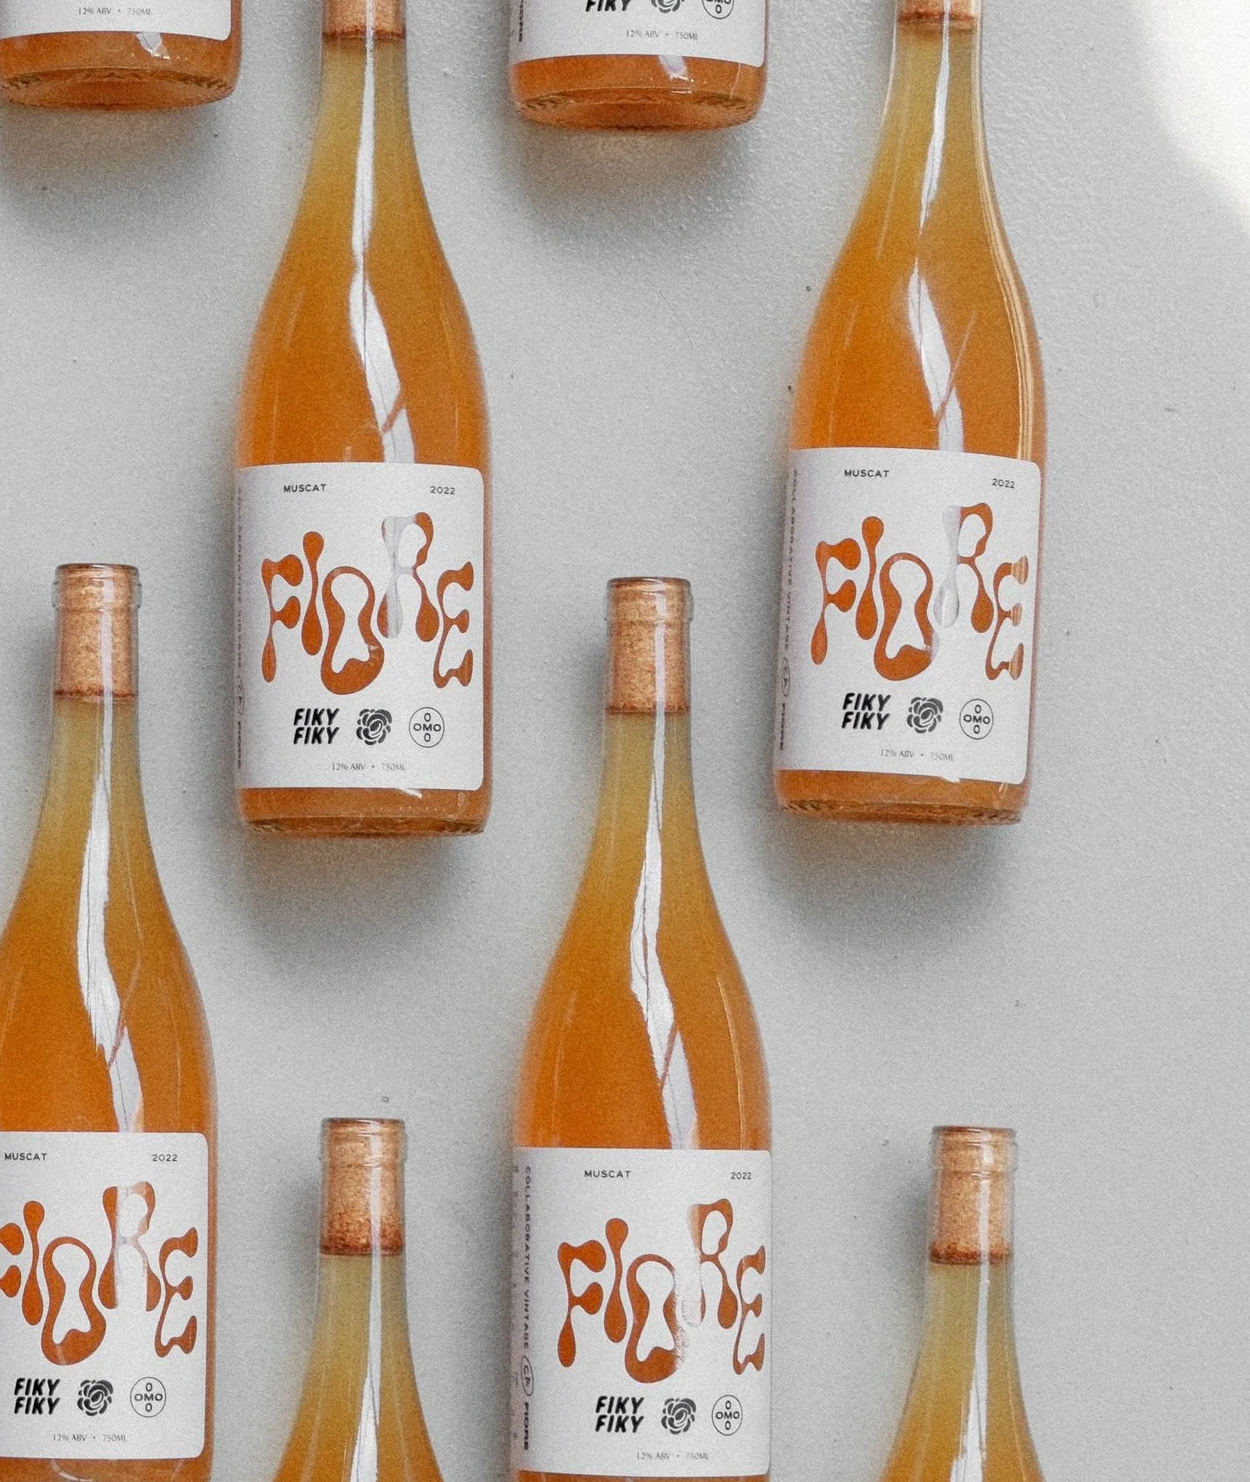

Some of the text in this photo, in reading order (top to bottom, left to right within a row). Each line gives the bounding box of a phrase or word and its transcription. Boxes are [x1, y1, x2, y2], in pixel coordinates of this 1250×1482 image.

[284, 484, 326, 492] MUSCAT
[431, 486, 455, 495] 2022
[992, 478, 1014, 489] 2022
[843, 693, 890, 711] FIKY
[294, 708, 338, 725] FIKY
[842, 712, 889, 729] FIKY
[294, 727, 339, 744] FIKY
[153, 1154, 177, 1162] 2022
[584, 1170, 630, 1178] MUSCAT
[731, 1172, 751, 1180] 2022
[14, 1378, 59, 1396] FIKY
[14, 1397, 59, 1414] FIKY
[596, 1396, 643, 1414] FIKY
[596, 1415, 643, 1432] FIKY
